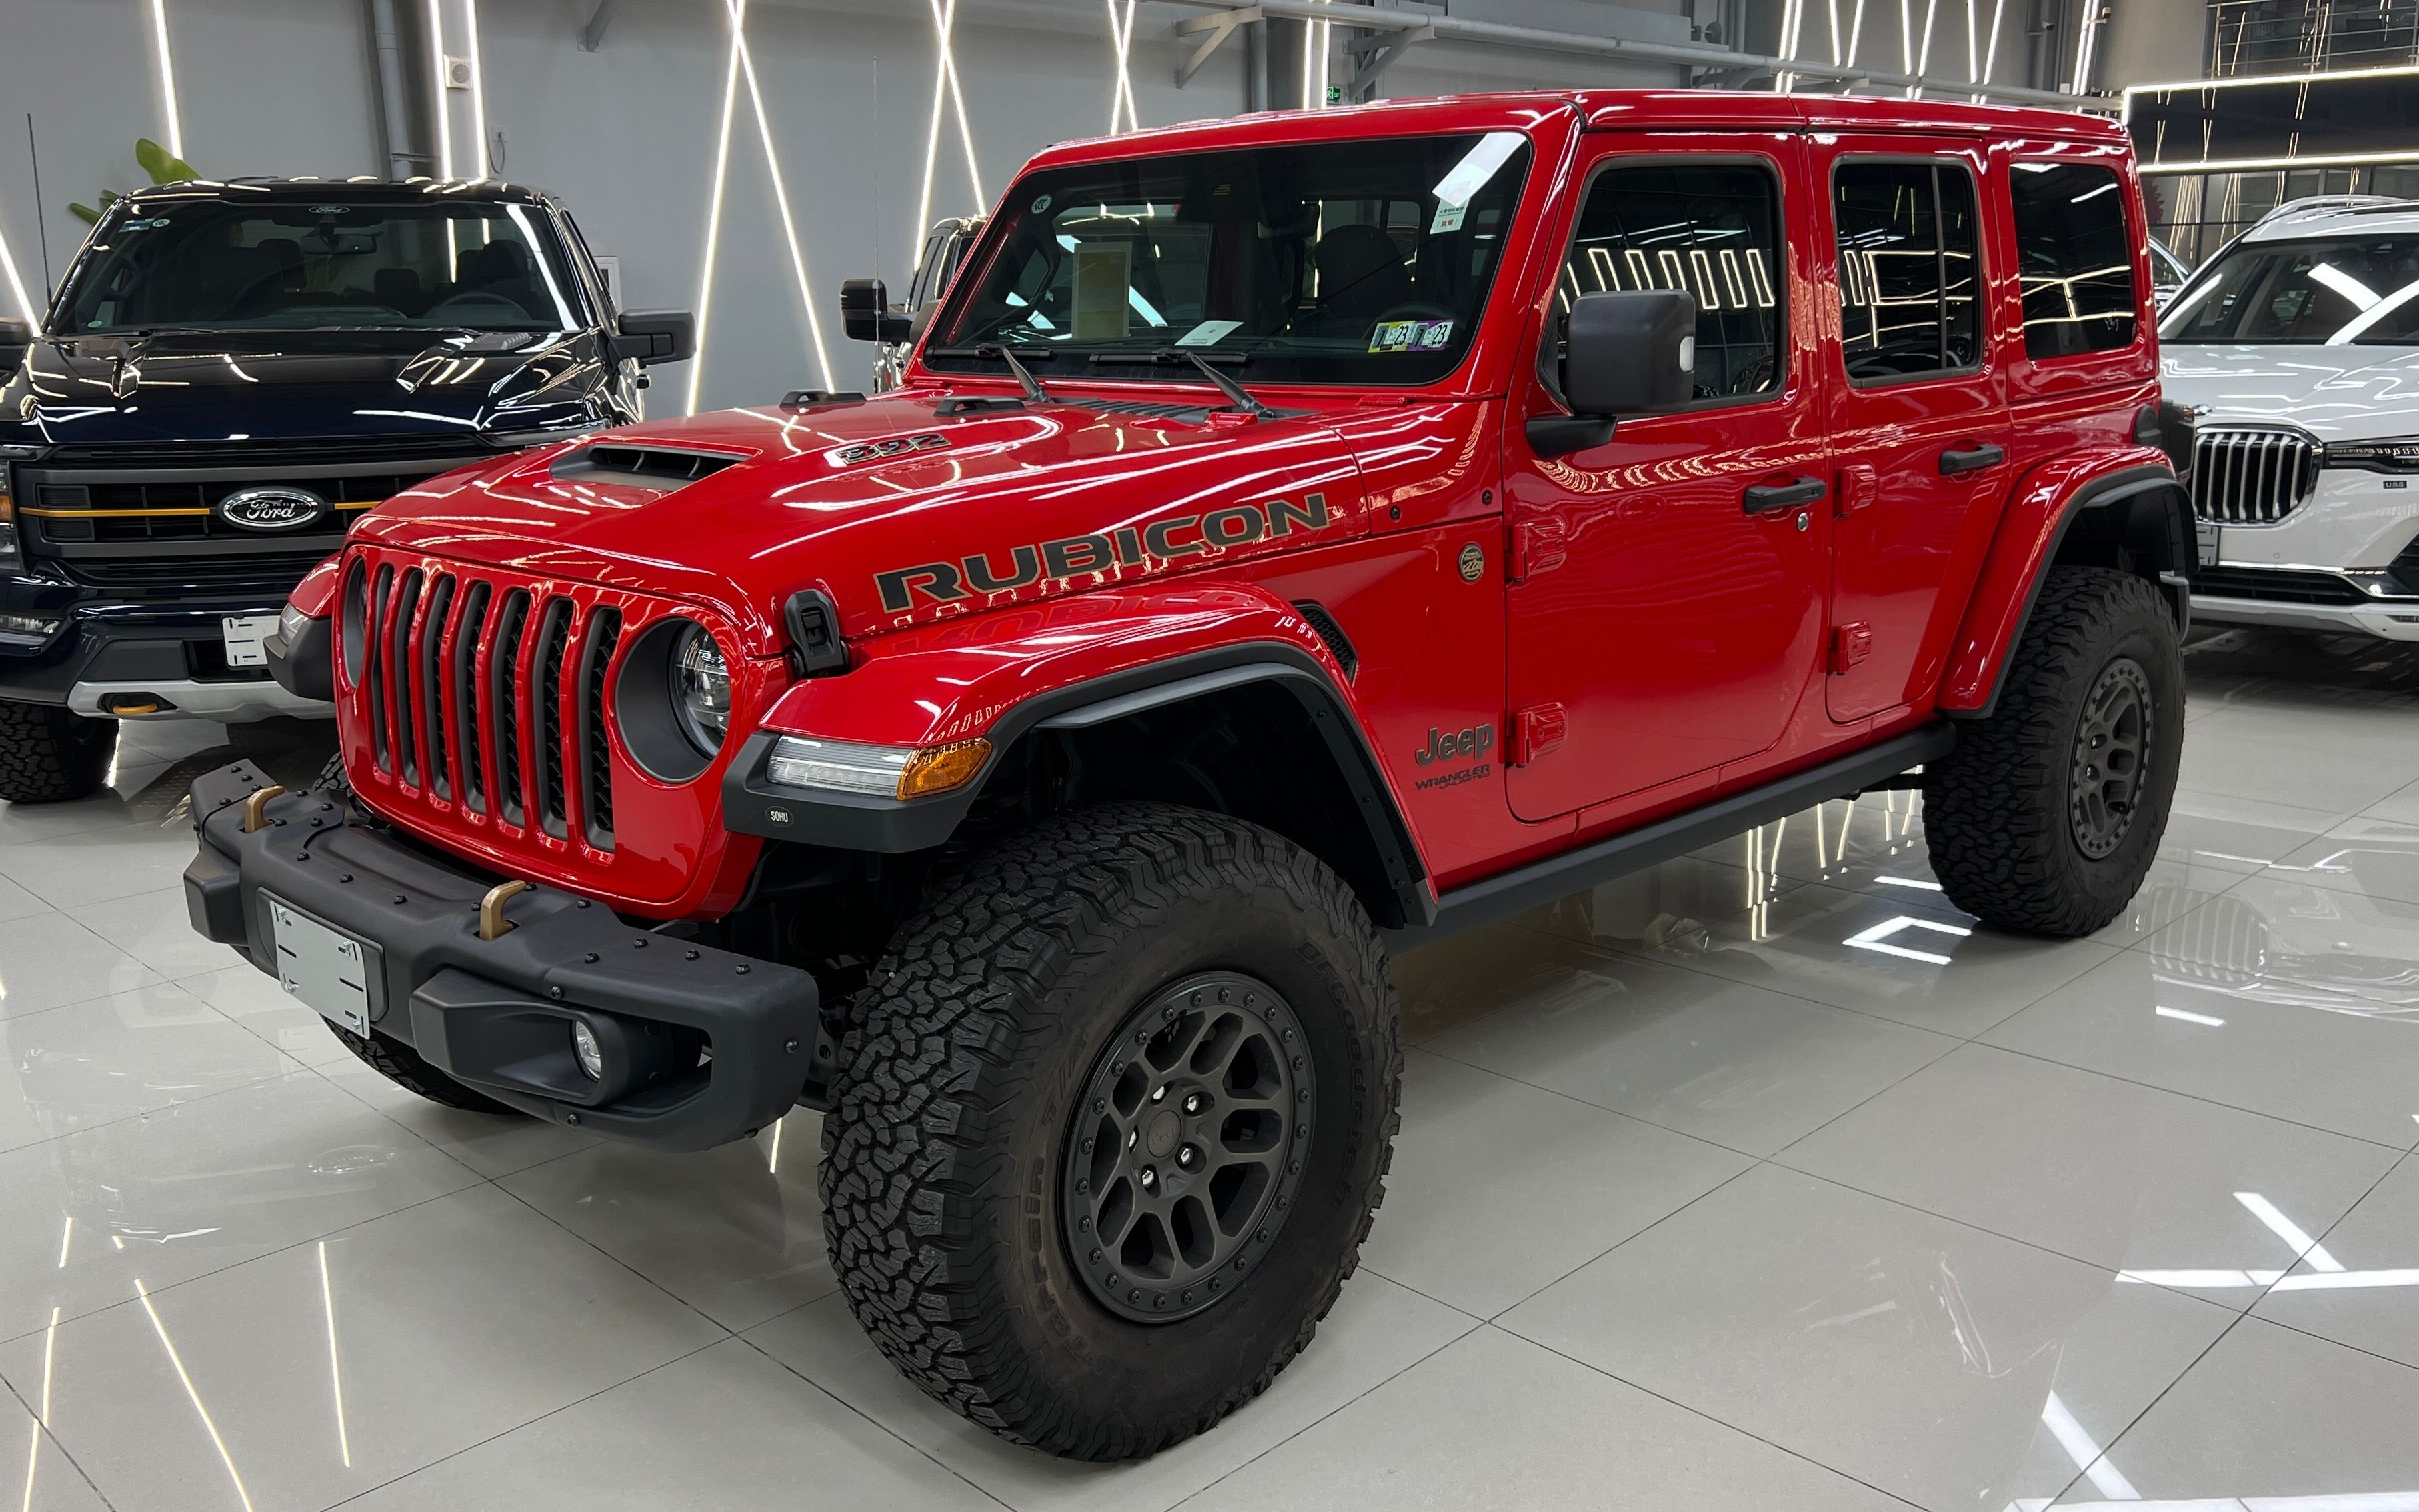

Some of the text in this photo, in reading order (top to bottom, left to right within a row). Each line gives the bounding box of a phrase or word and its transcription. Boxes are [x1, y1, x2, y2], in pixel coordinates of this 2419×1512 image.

[1394, 325, 1409, 346] 23
[1432, 325, 1448, 345] 23
[836, 433, 951, 465] 392
[246, 499, 296, 519] Ford
[873, 492, 1329, 614] RUBICON
[1415, 723, 1494, 767] Jeep
[1414, 764, 1490, 790] WRANGLER
[1439, 772, 1491, 789] UNLIMITED
